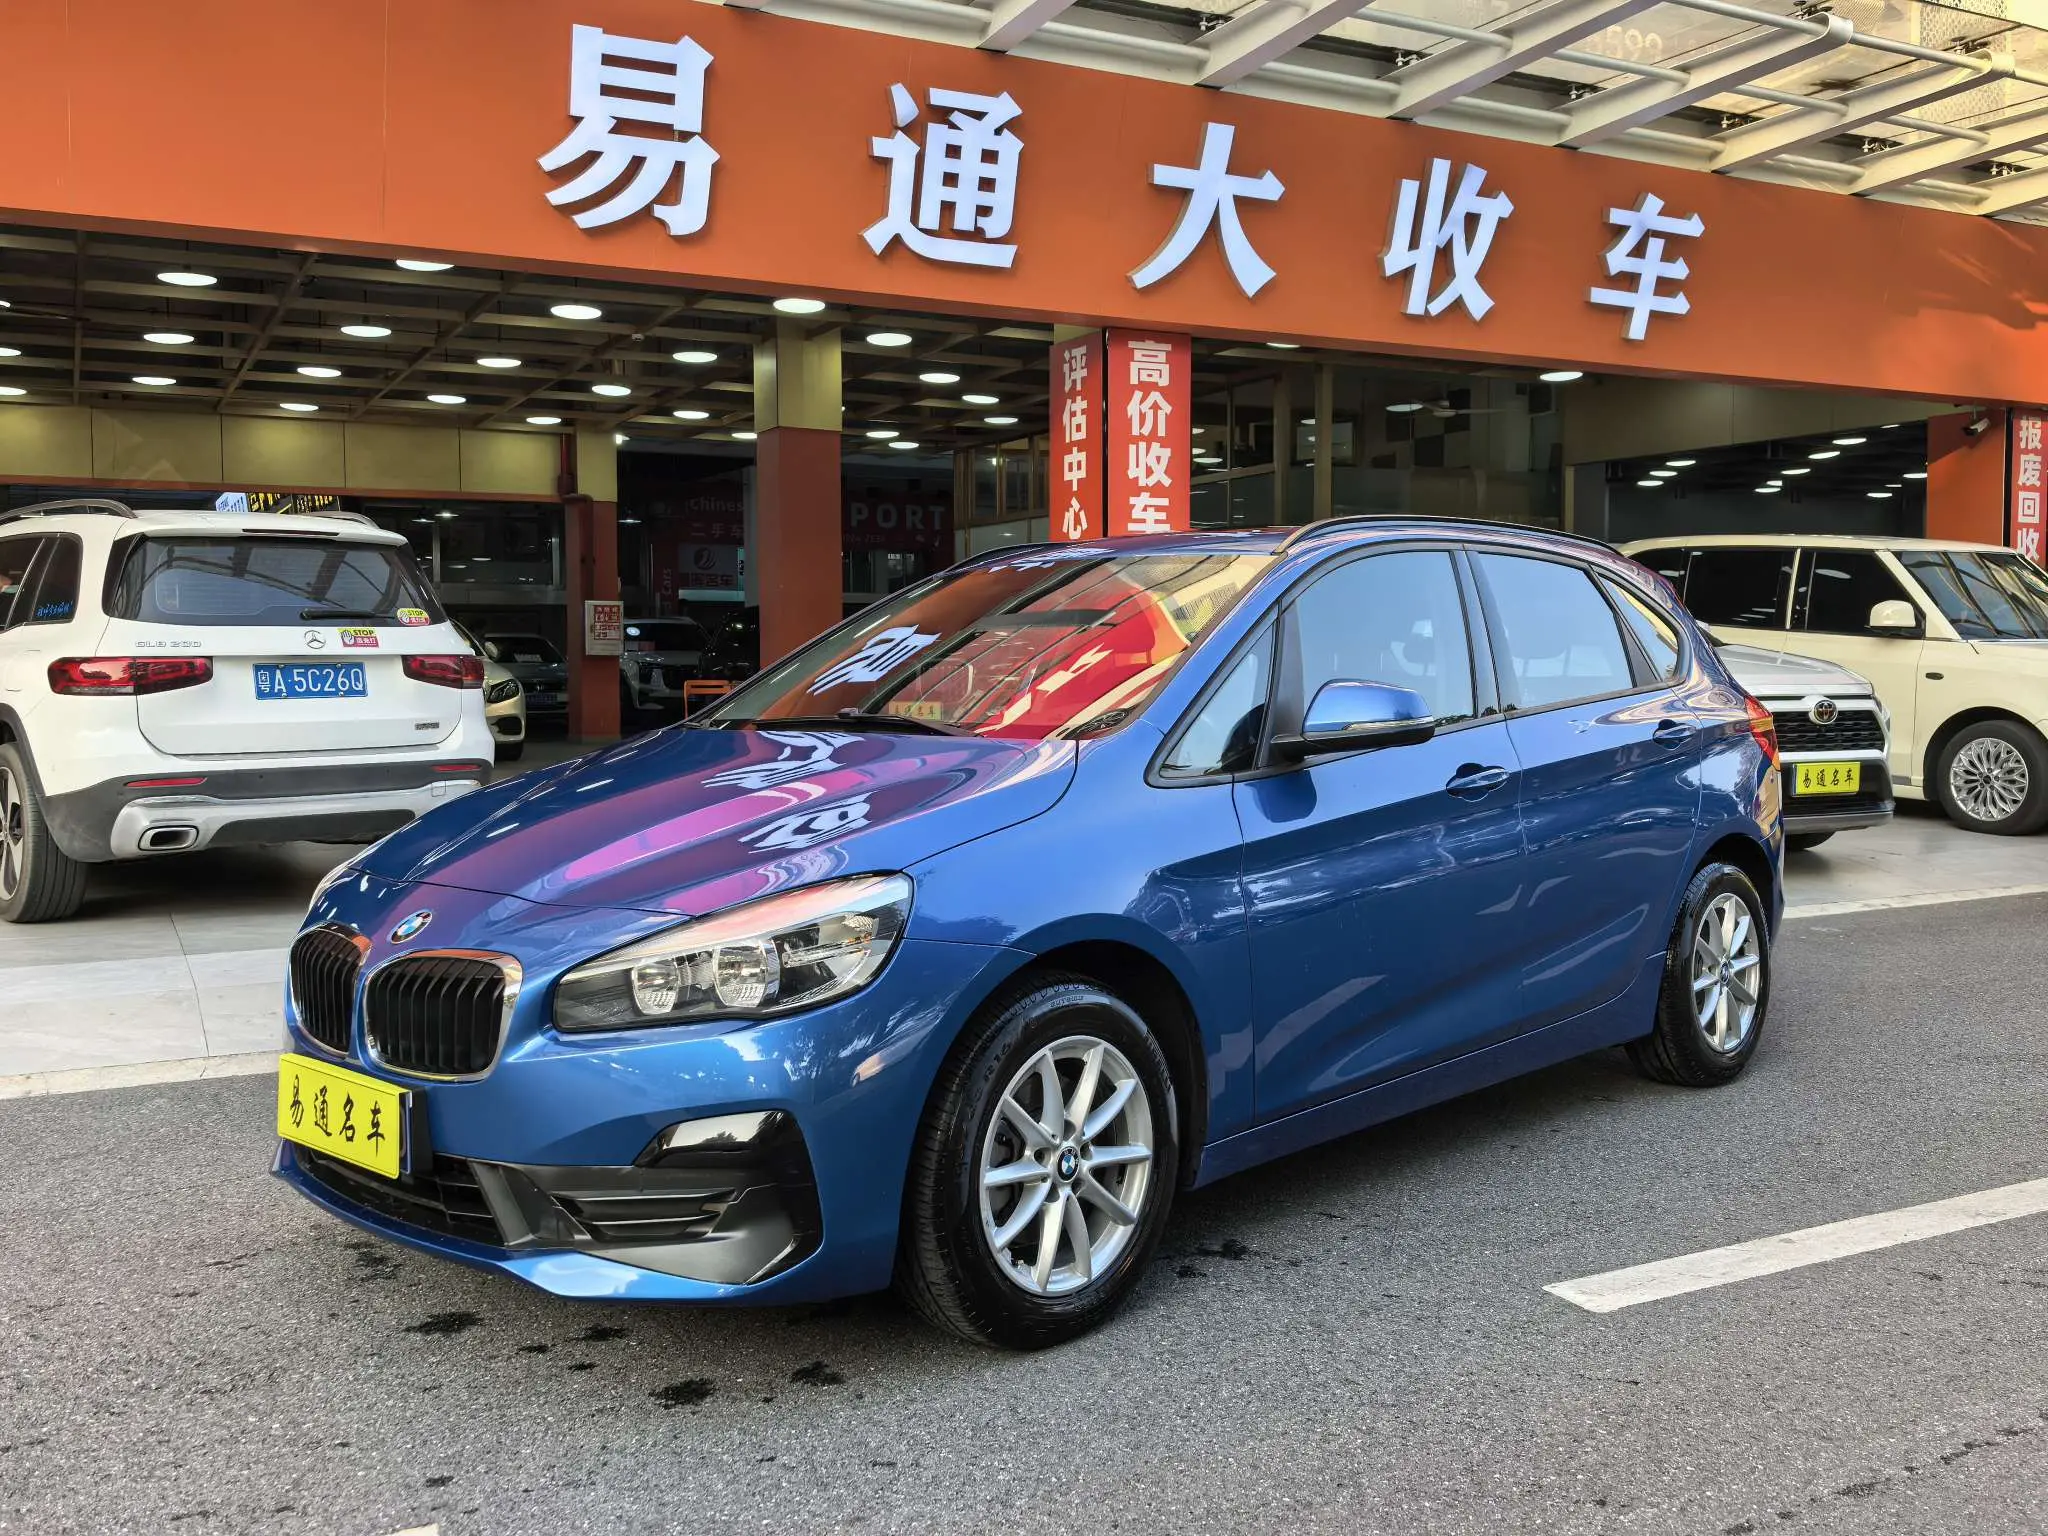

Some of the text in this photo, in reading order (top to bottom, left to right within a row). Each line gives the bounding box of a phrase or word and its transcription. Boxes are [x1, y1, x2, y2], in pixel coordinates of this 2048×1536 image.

[537, 23, 1706, 341] 易通大收车
[1062, 345, 1088, 540] 评估中心
[1126, 340, 1173, 534] 高价收车
[2016, 415, 2042, 561] 报废回收
[850, 501, 946, 530] PORT
[1803, 768, 1854, 789] 易通名车
[289, 1073, 386, 1158] 易通名车
